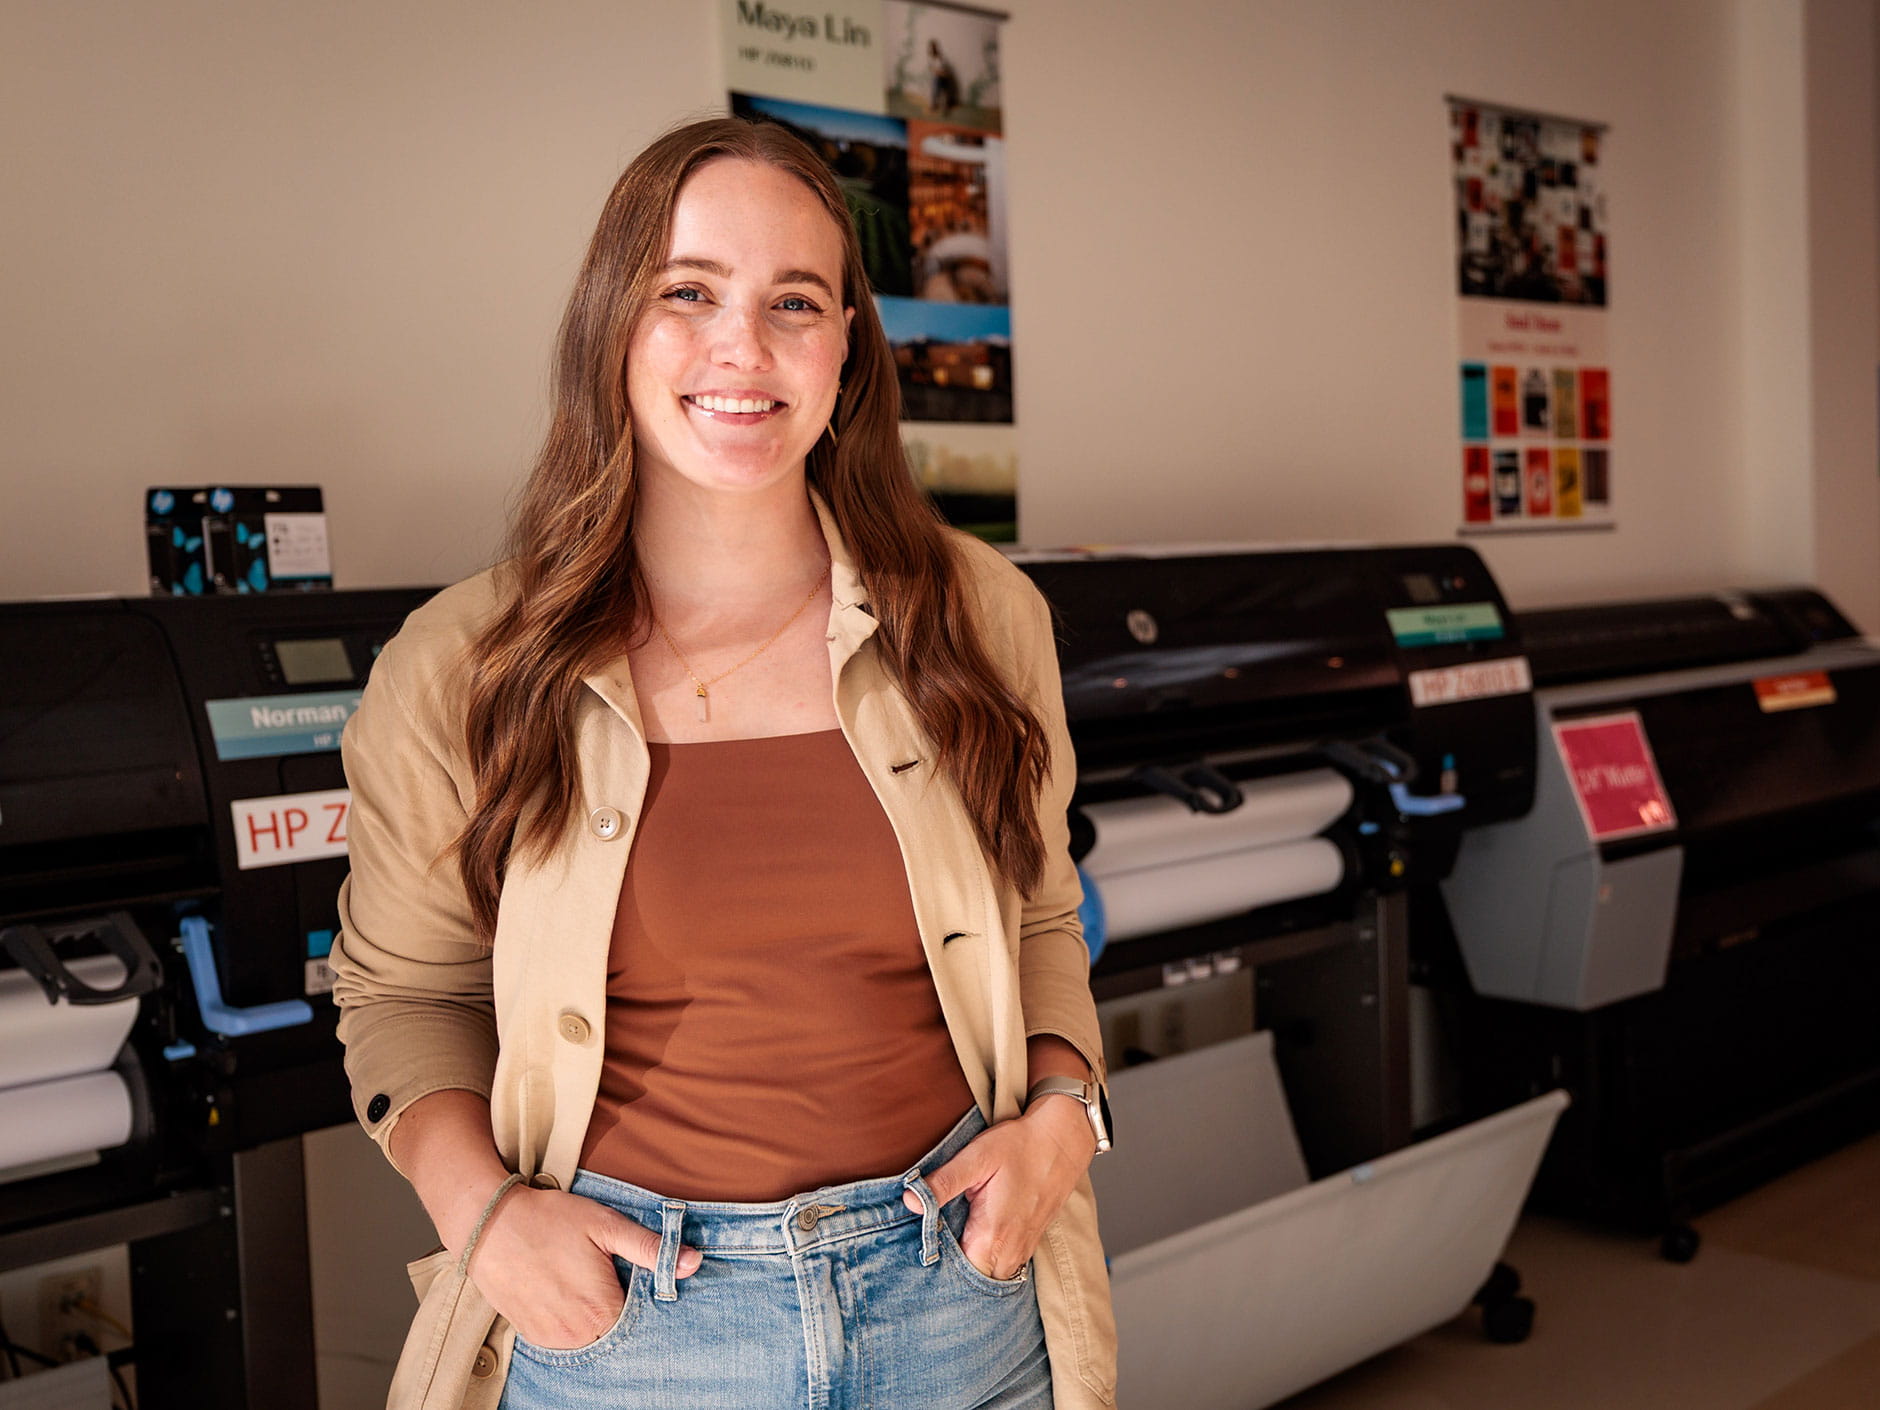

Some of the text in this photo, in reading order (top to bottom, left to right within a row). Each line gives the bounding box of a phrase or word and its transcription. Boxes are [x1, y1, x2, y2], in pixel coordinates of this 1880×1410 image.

[737, 0, 872, 47] Maya Lin
[251, 703, 347, 728] Norman
[313, 734, 332, 748] HP
[247, 808, 309, 853] HP
